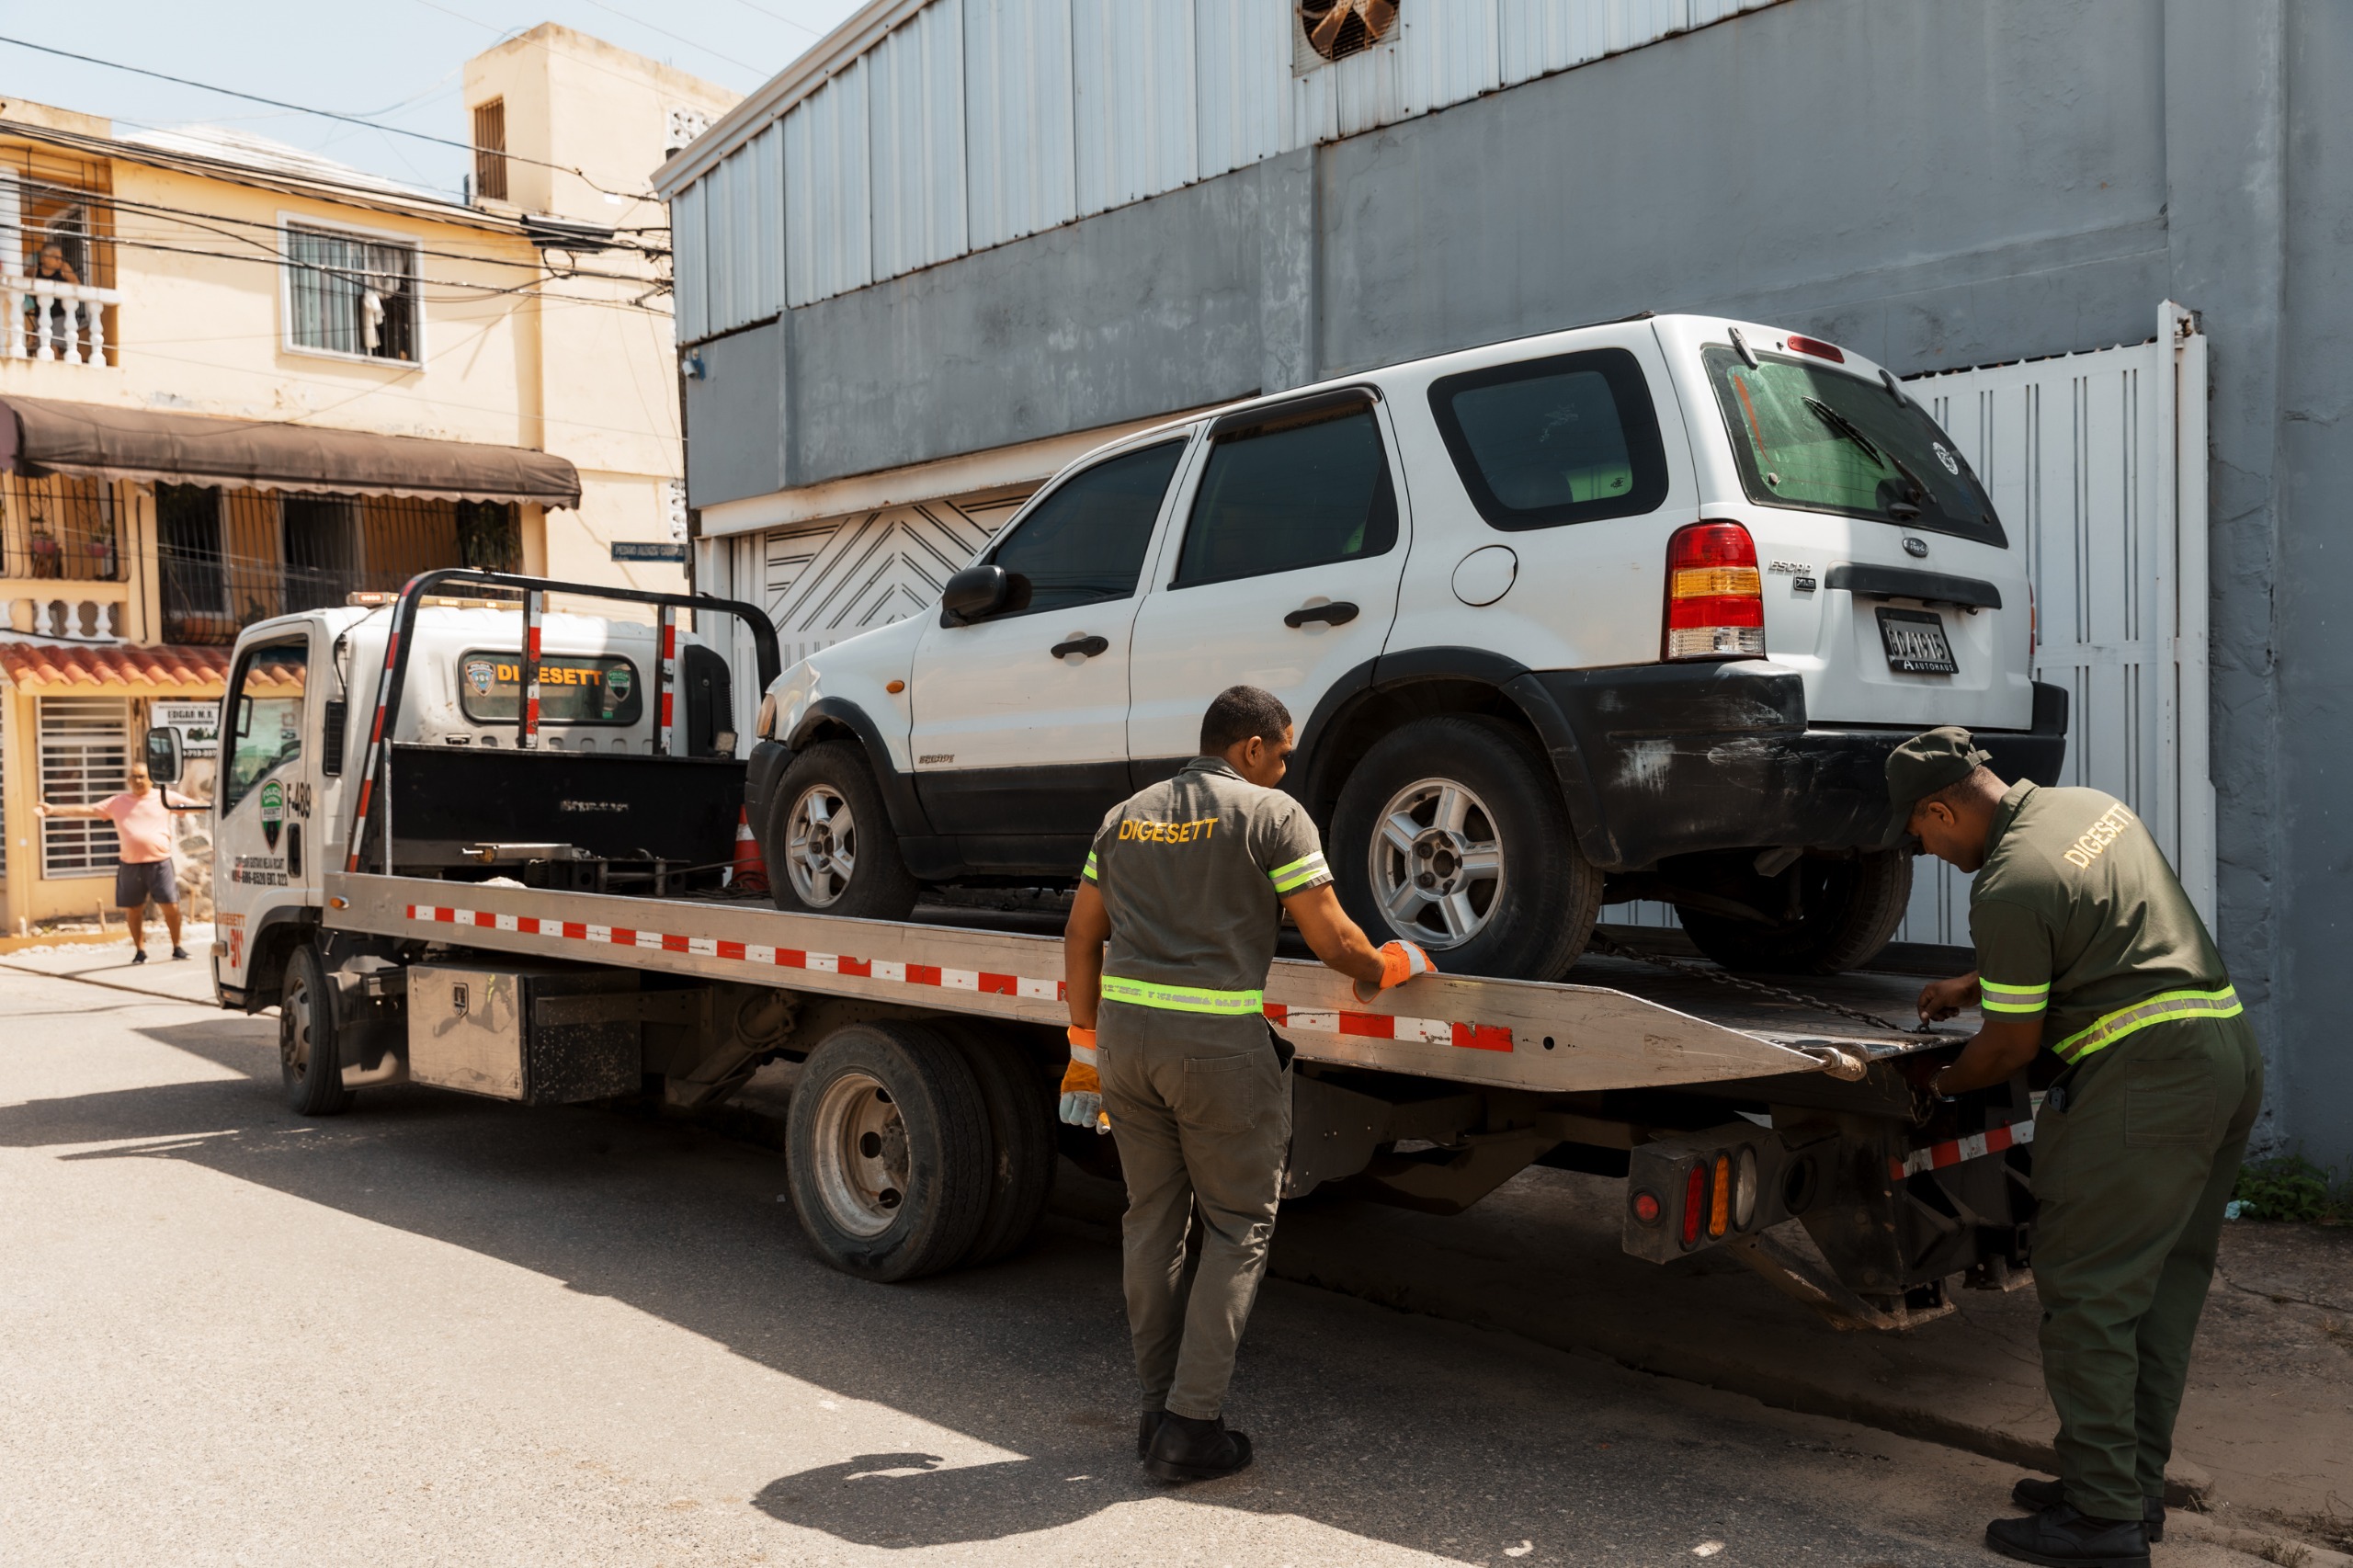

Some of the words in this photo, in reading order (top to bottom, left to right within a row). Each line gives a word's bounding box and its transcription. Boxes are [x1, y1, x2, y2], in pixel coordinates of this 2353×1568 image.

[496, 665, 602, 686] DIESETT
[1915, 663, 1954, 672] AUTOHAUS
[286, 781, 312, 819] F-489
[1119, 817, 1220, 844] DIGESETT
[2063, 802, 2134, 869] DIGESETT
